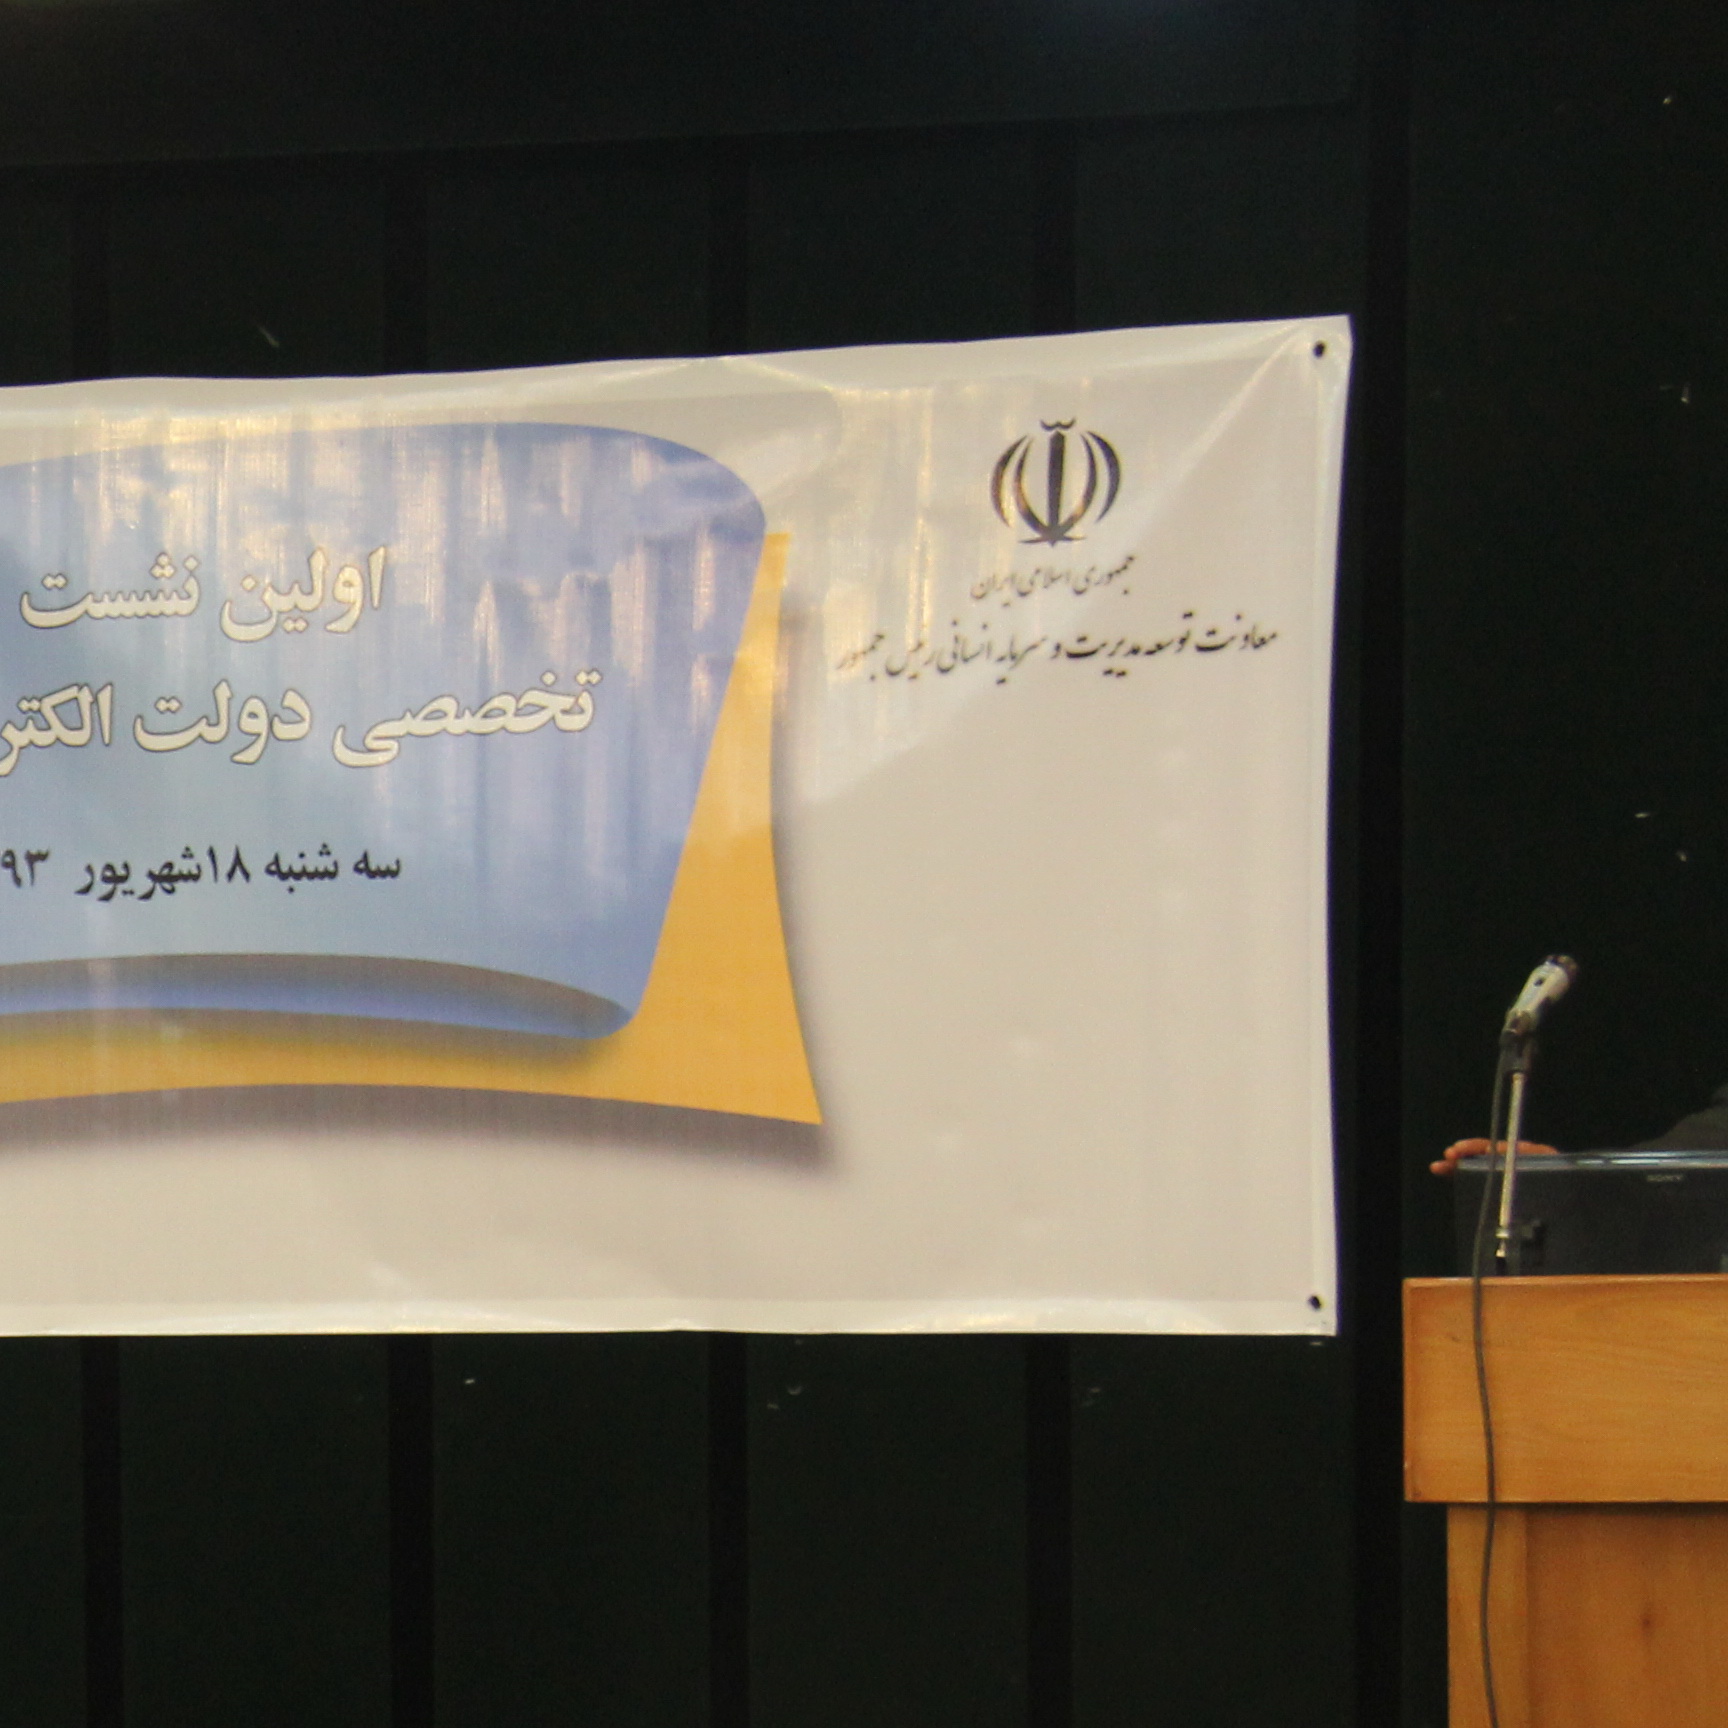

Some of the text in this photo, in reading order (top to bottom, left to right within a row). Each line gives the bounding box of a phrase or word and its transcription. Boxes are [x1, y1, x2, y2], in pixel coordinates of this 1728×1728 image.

[19, 545, 387, 642] اولین نشست
[133, 679, 310, 763] دولت
[331, 667, 601, 767] تخصصی
[266, 843, 339, 885] شنبه
[352, 853, 402, 882] سه
